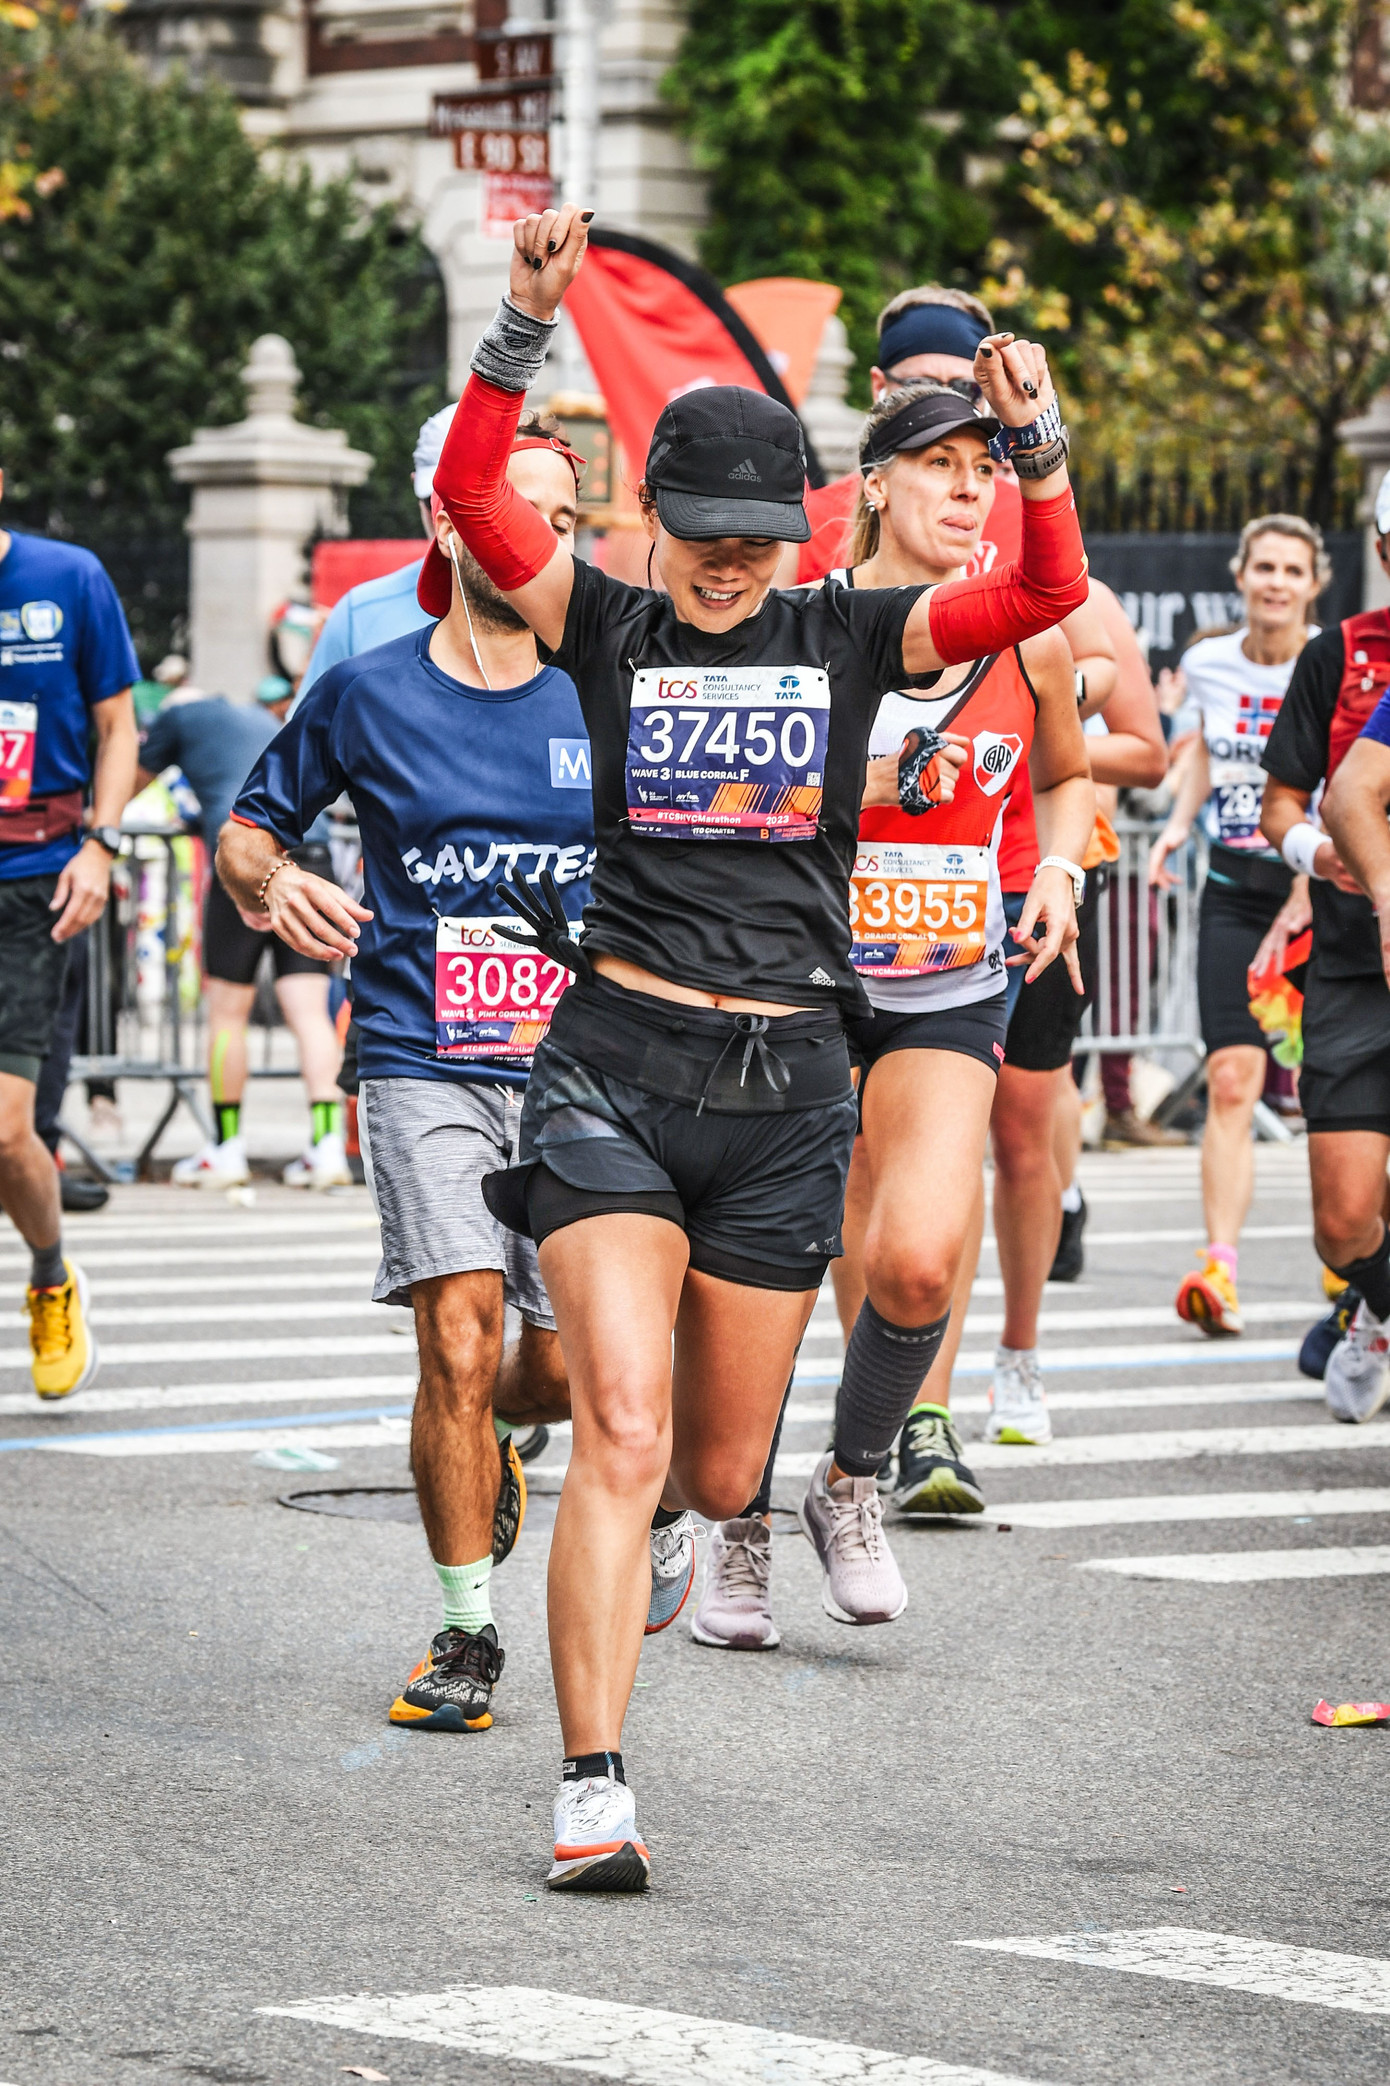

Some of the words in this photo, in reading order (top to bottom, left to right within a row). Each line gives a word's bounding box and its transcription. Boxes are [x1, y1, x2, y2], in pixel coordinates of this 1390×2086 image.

[728, 471, 762, 483] adidas
[658, 676, 698, 699] tcs
[703, 684, 761, 692] CONSULTANCY
[702, 692, 739, 700] SERVICES
[775, 692, 802, 700] TATA
[640, 710, 816, 767] 37450
[631, 768, 659, 778] WAVE
[660, 767, 671, 780] 3
[675, 770, 699, 779] BLUE
[700, 771, 739, 780] CORRAL
[740, 769, 750, 781] F
[766, 815, 789, 825] 2023
[760, 828, 769, 839] B
[883, 866, 913, 874] SERVICES
[943, 867, 965, 875] TATA
[460, 925, 495, 947] tcs
[864, 932, 897, 940] ORANGE
[898, 932, 927, 940] CORRAL
[446, 956, 577, 1006] 3082
[441, 1010, 465, 1018] WAVE
[498, 1011, 530, 1019] CORRAL
